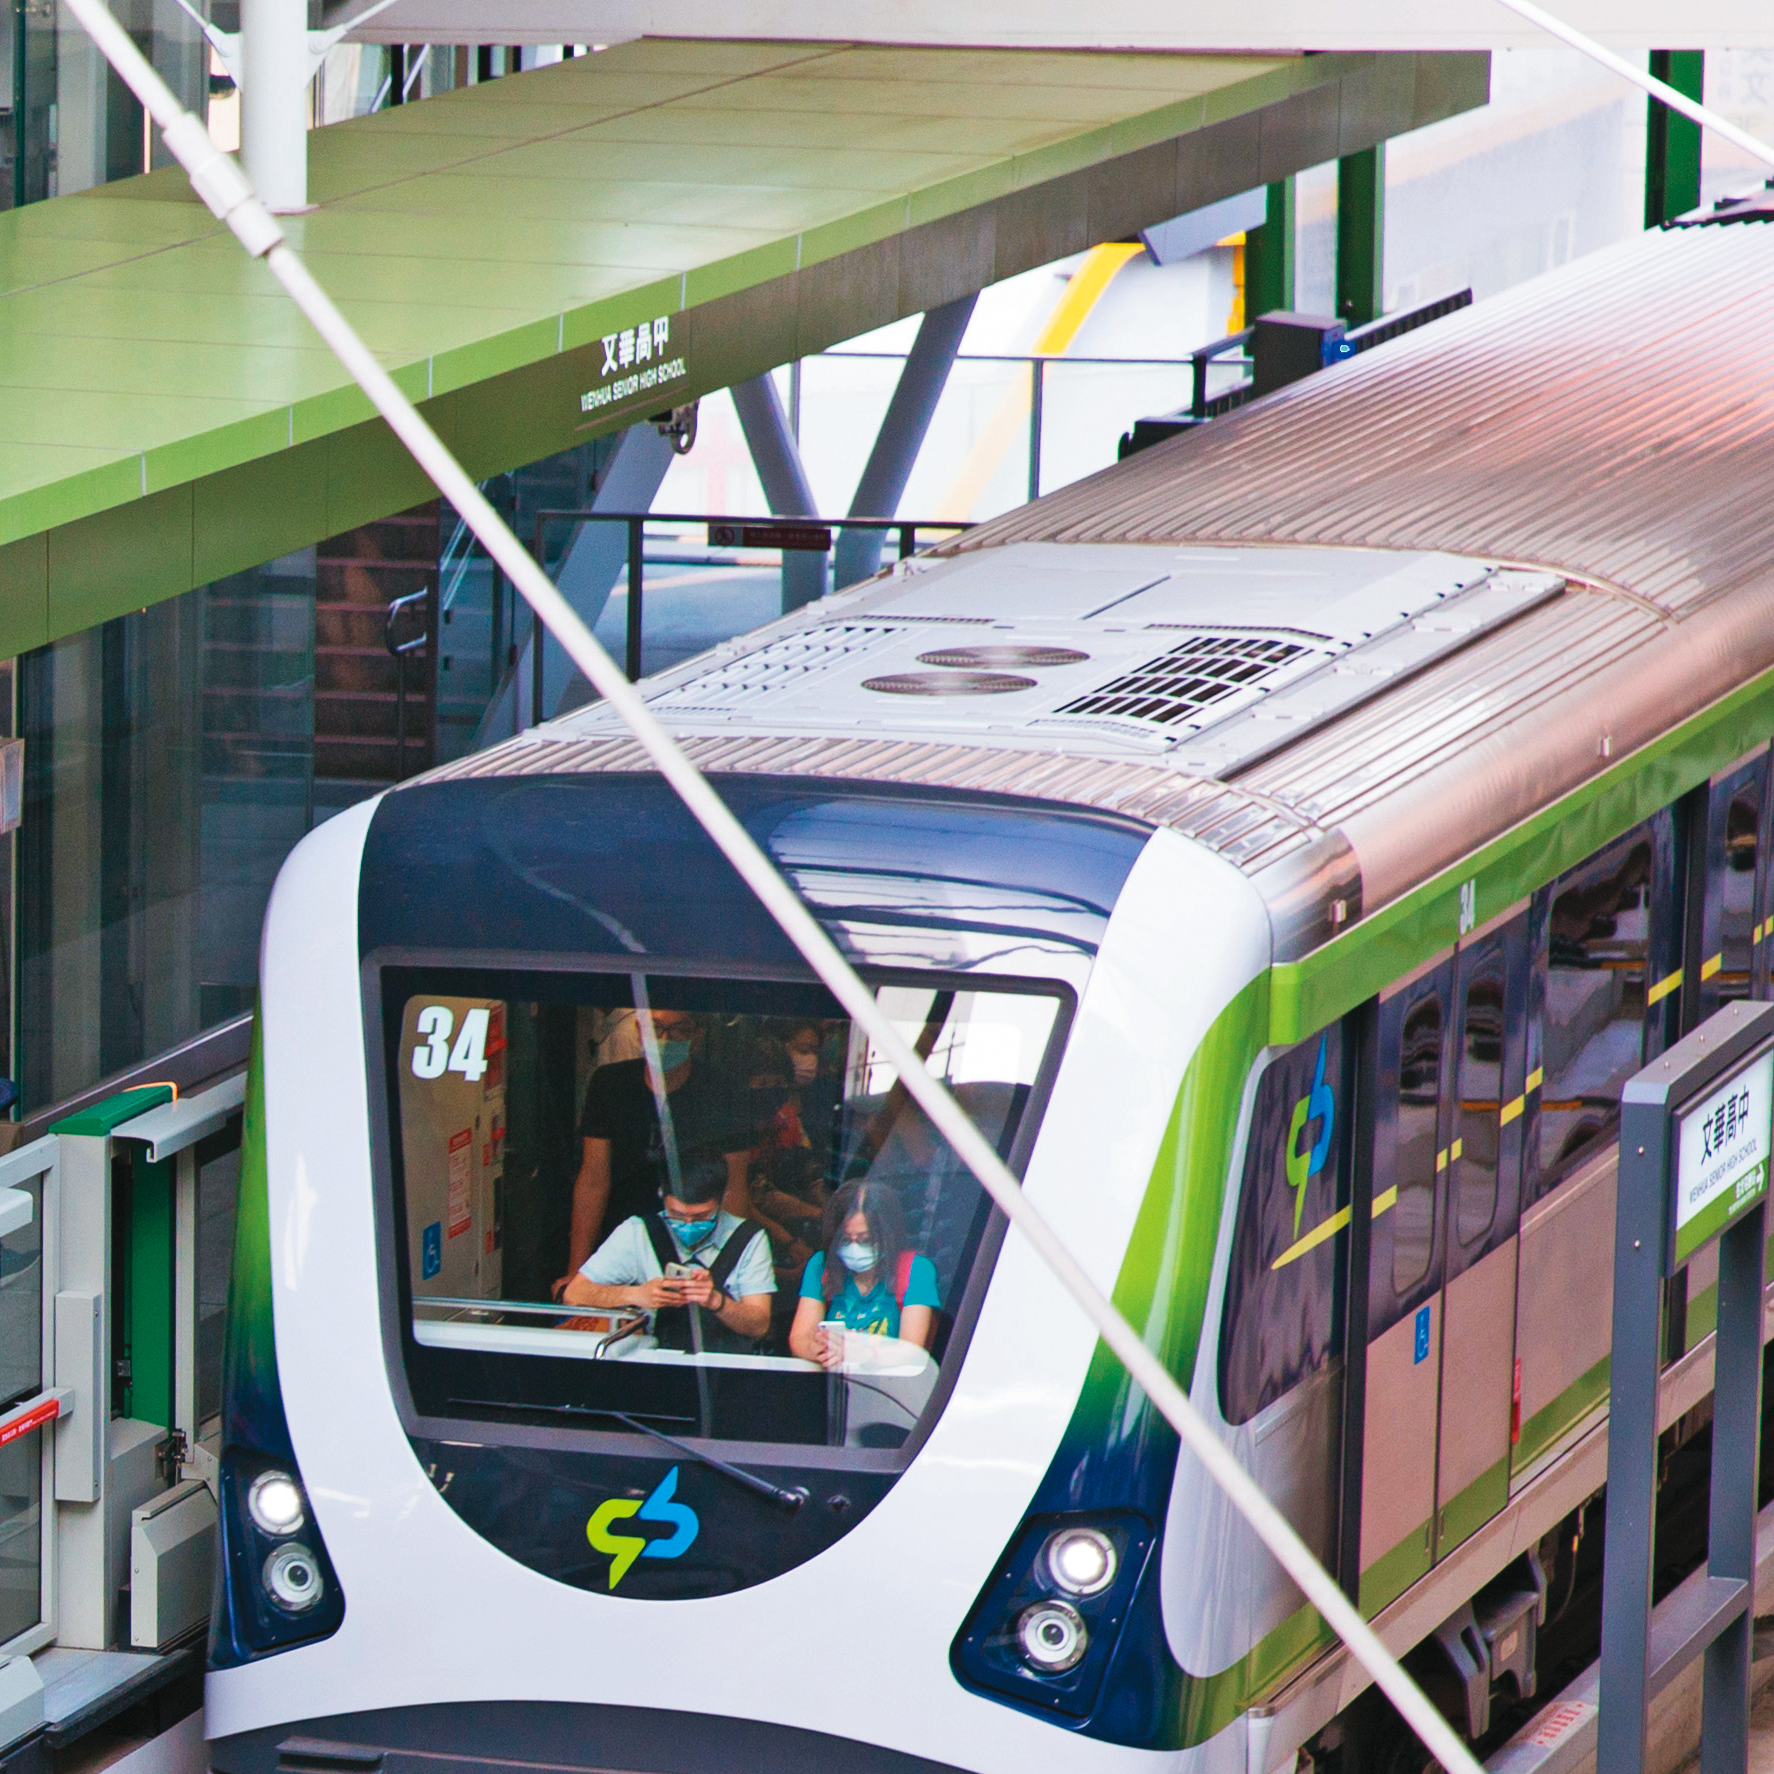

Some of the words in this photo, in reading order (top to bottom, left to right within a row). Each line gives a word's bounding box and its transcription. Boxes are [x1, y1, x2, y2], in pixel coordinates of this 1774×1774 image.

[580, 384, 612, 412] WENHUA
[613, 374, 639, 401] SENIOR
[639, 367, 657, 391] HIGH
[657, 357, 686, 384] SCHOOL
[411, 1005, 491, 1082] 34
[1700, 1084, 1750, 1167] 文華高中
